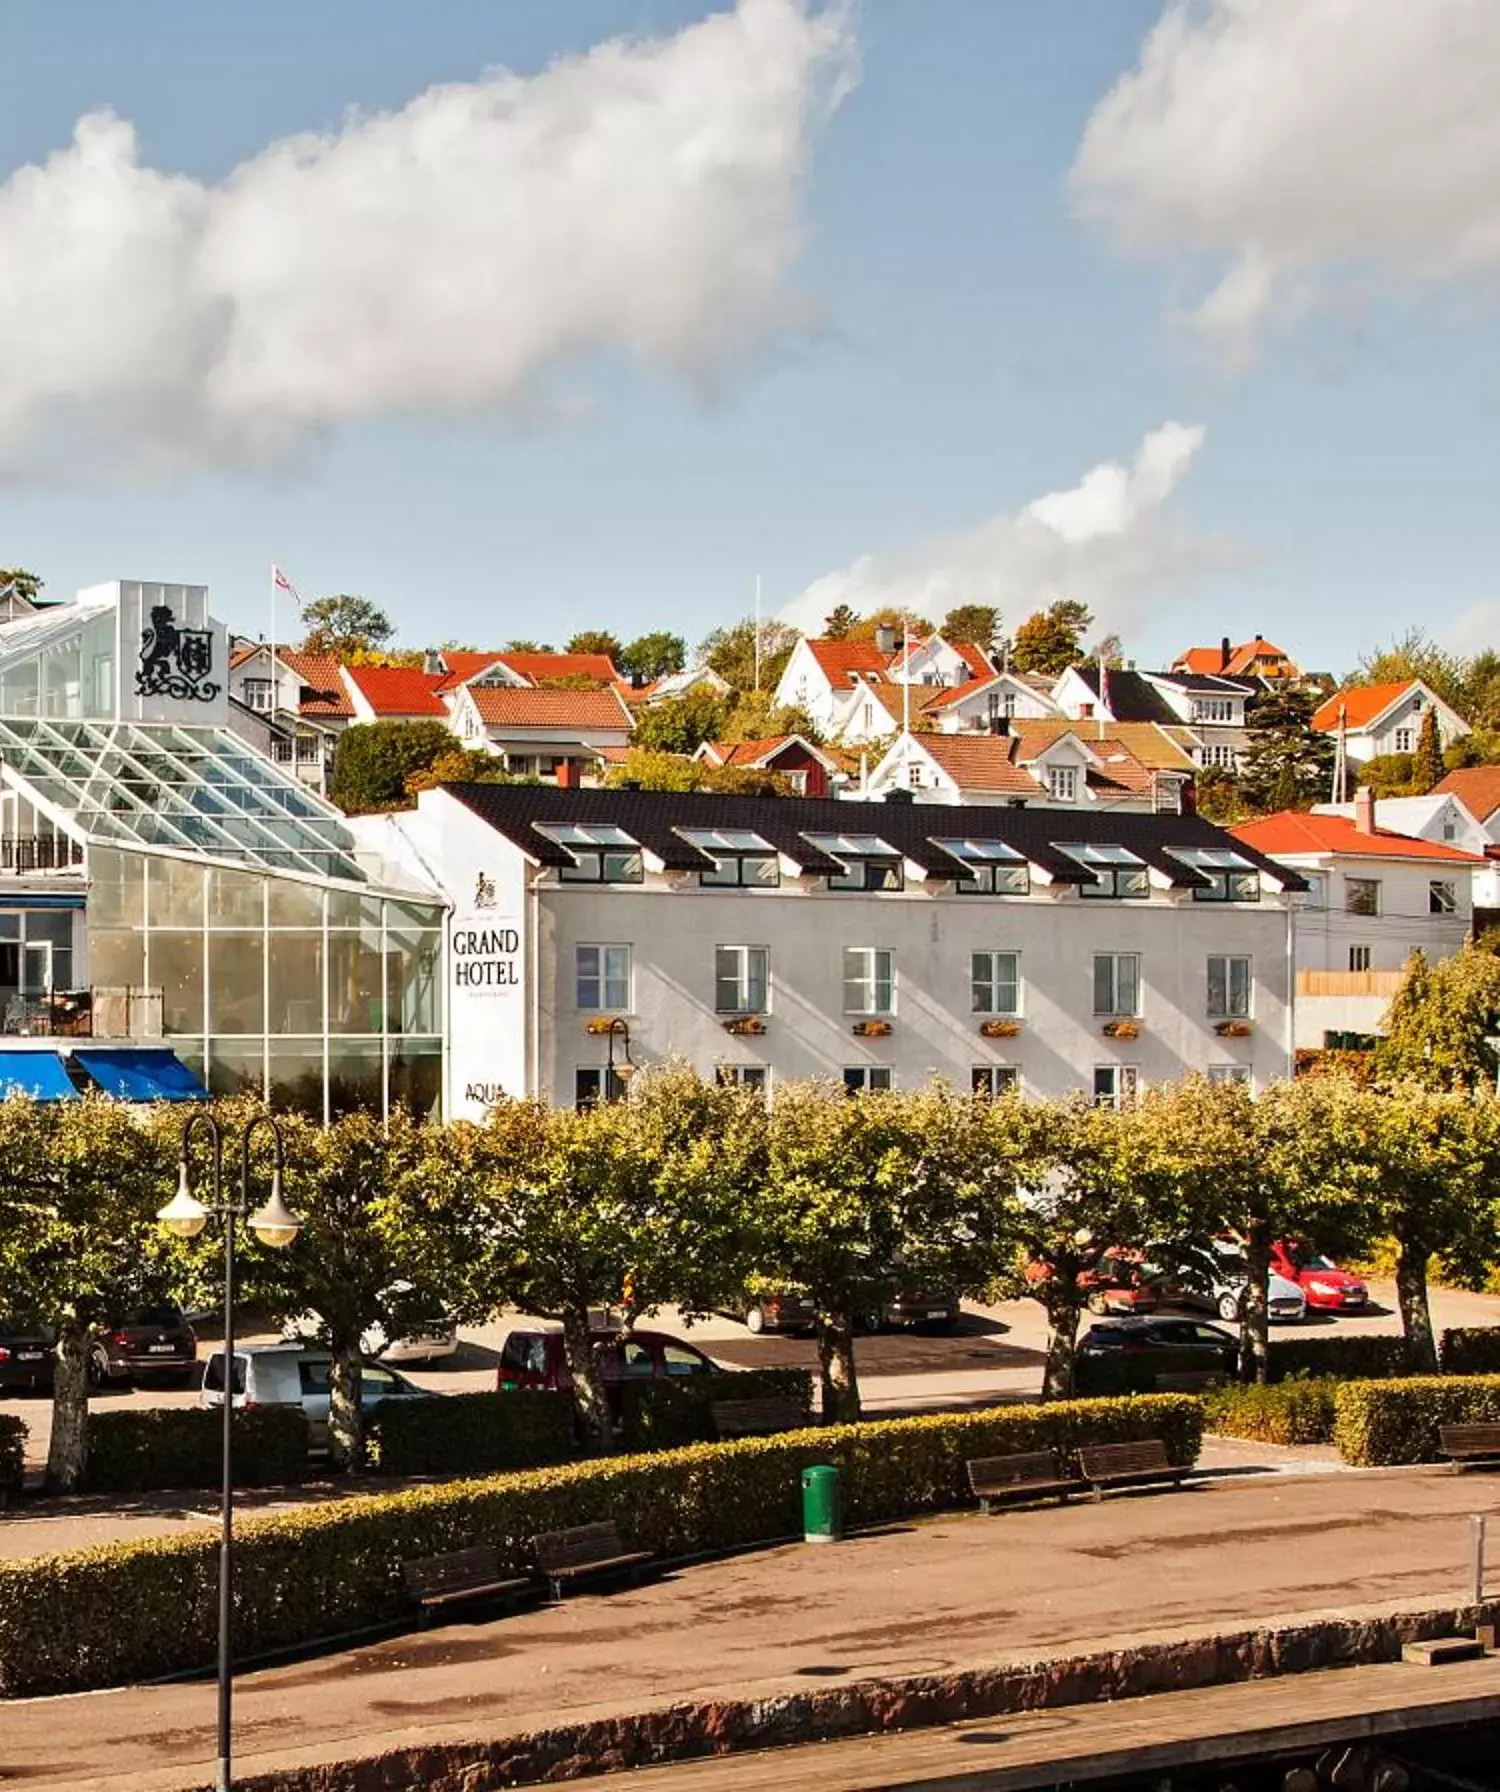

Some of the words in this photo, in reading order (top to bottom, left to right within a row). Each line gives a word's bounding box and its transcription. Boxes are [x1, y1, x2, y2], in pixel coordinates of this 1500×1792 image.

[453, 929, 518, 955] GRAND
[455, 961, 518, 986] HOTEL
[465, 1083, 506, 1105] AQUA
